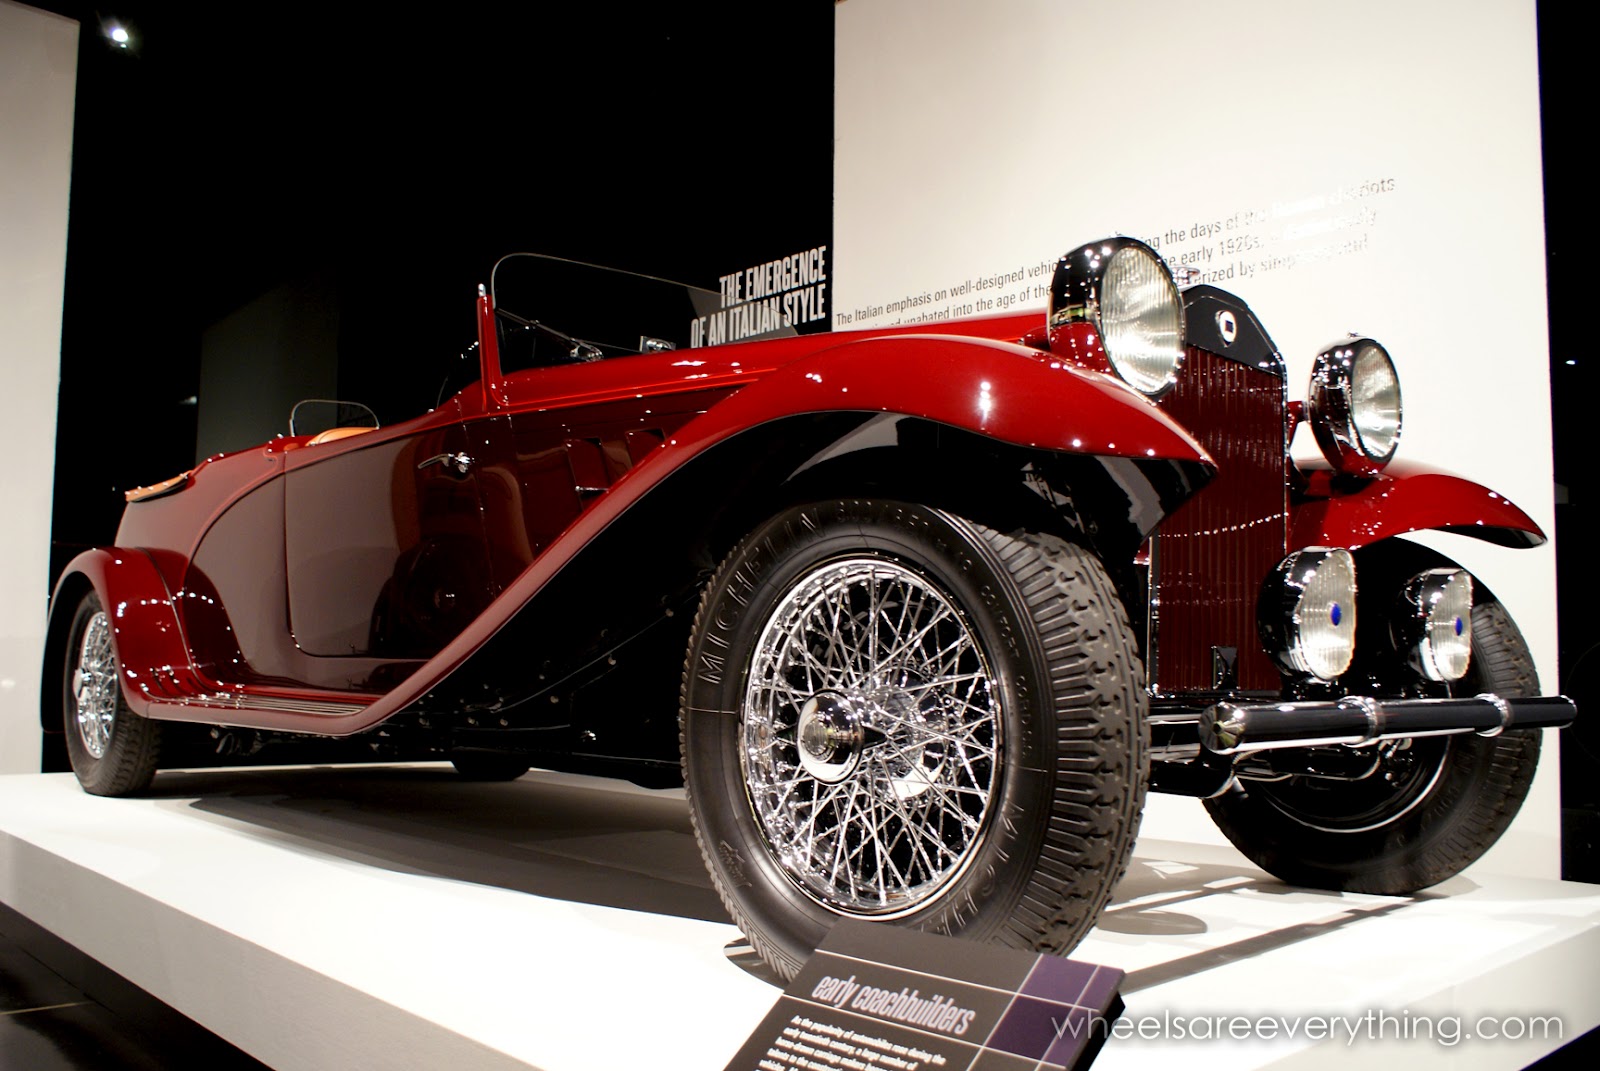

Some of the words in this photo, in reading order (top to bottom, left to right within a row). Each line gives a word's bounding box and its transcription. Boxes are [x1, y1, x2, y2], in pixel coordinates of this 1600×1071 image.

[1165, 229, 1186, 245] the
[1190, 221, 1221, 240] days
[1181, 246, 1213, 265] early
[719, 271, 743, 309] THE
[745, 245, 826, 301] EMERGENCE
[836, 312, 853, 326] The
[855, 304, 884, 321] Italian
[886, 291, 932, 313] emphasis
[934, 289, 947, 302] on
[950, 266, 1025, 297] well-designed
[1028, 261, 1057, 278] vehic
[1240, 261, 1256, 279] by
[690, 316, 707, 349] OF
[708, 310, 727, 346] AN
[728, 295, 780, 342] ITALIAN
[783, 283, 826, 328] STYLE
[953, 303, 973, 319] into
[976, 298, 993, 313] the
[997, 292, 1016, 309] age
[1020, 288, 1031, 302] of
[1034, 284, 1051, 299] the
[697, 508, 826, 684] MICHELIN
[921, 802, 1025, 937] MICHE
[811, 975, 861, 1009] early
[852, 987, 977, 1036] coachbuilders
